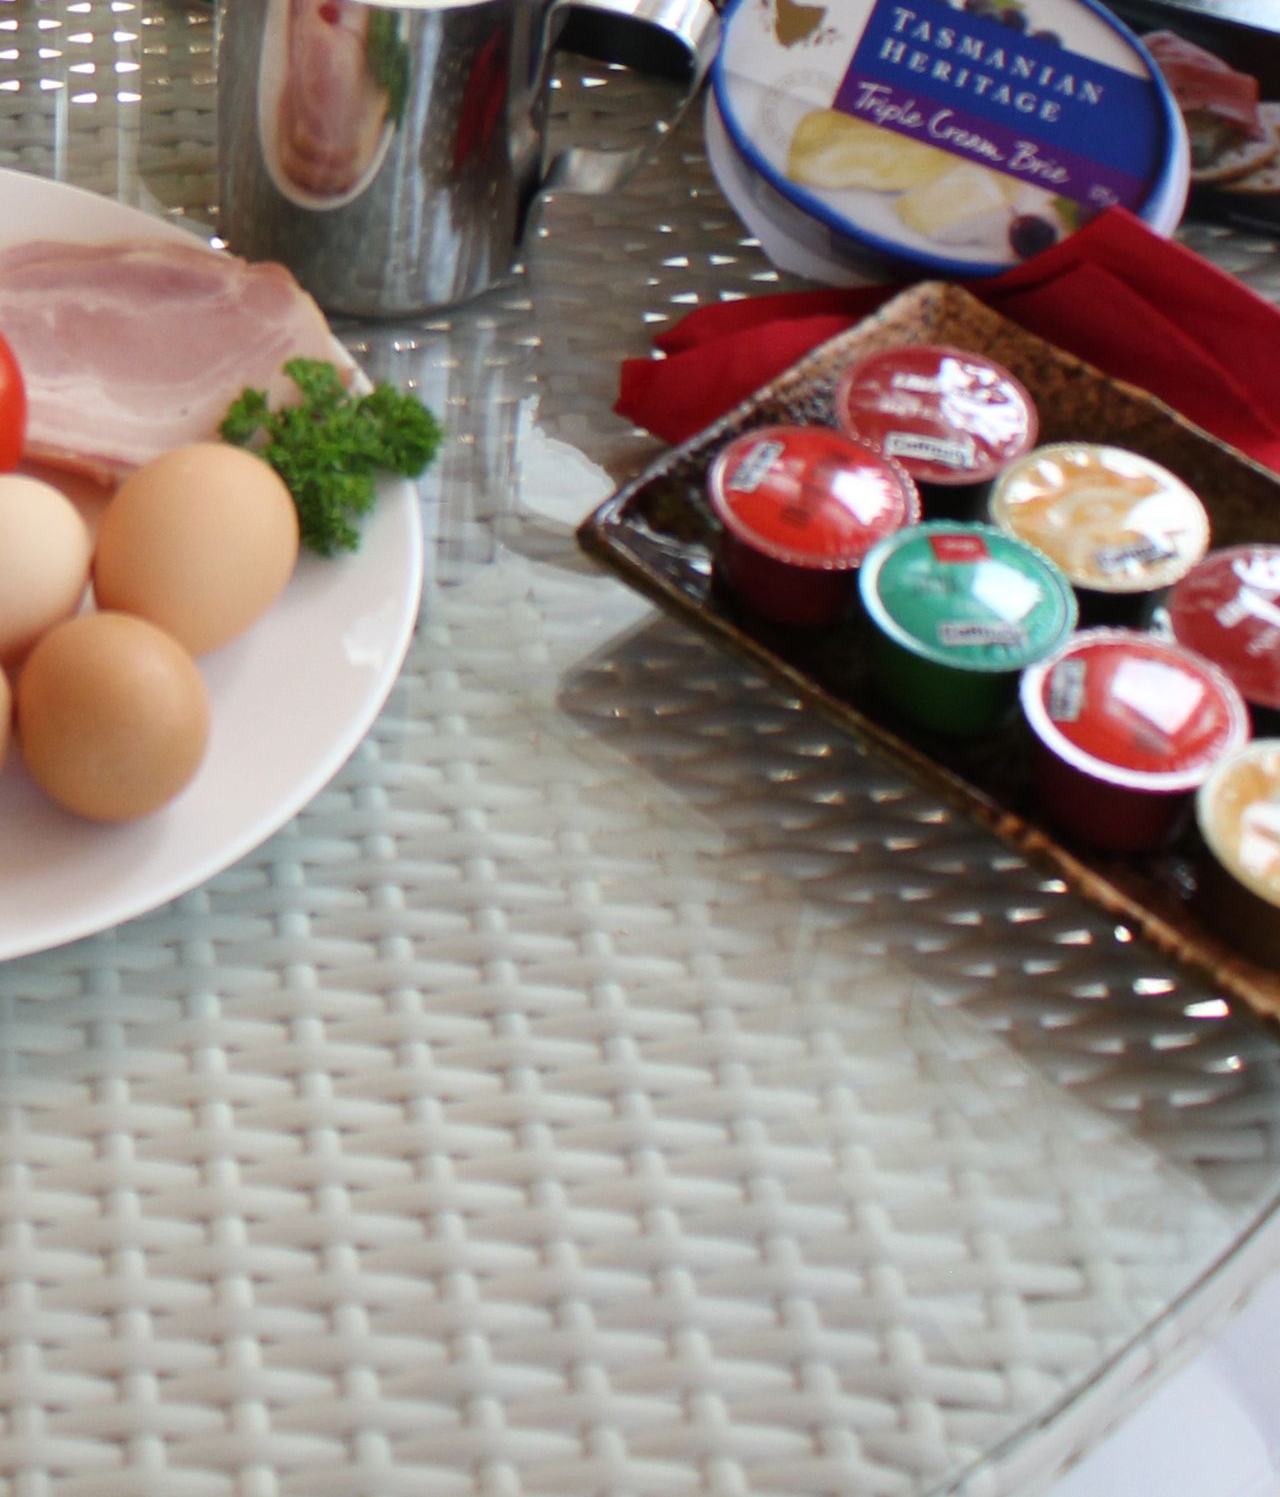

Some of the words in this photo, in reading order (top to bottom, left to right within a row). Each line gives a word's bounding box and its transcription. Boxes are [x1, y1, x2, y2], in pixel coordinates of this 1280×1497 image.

[879, 36, 1062, 124] HERITAGE
[893, 6, 1105, 106] TASMANIAN
[853, 80, 925, 130] Triple
[928, 108, 1006, 162] Cream
[1007, 140, 1071, 185] Brie
